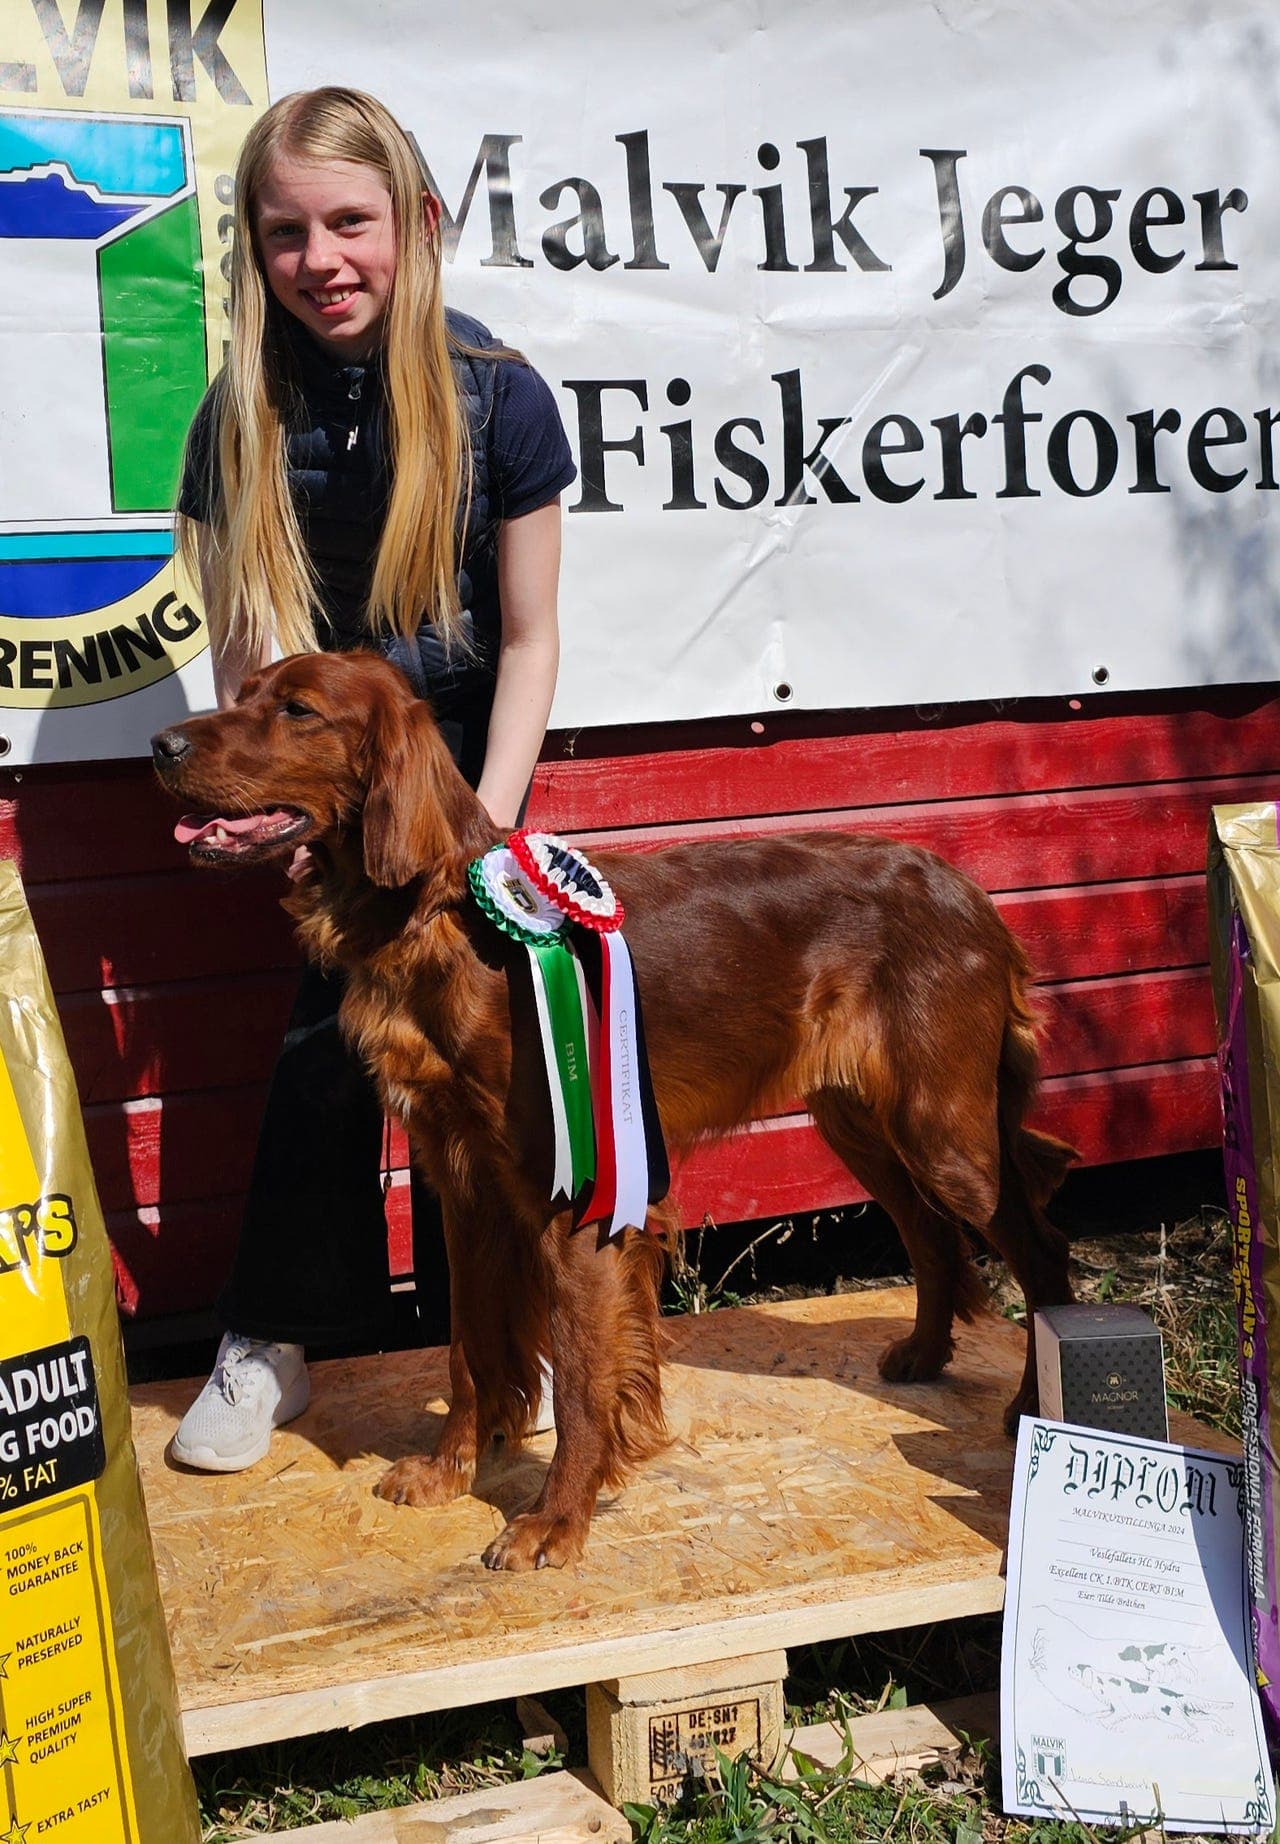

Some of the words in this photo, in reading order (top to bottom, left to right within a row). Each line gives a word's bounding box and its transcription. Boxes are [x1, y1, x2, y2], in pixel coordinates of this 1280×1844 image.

[405, 129, 892, 274] Malvik
[918, 149, 1250, 317] Jeger
[565, 1042, 577, 1083] BIM
[618, 1008, 633, 1126] CERTIFIKAT
[0, 1350, 87, 1416] ADULT
[1091, 1390, 1139, 1403] MAGNOR
[25, 1406, 95, 1455] FOOD
[1246, 1380, 1261, 1508] PROFESSIONAL
[23, 1458, 58, 1492] FAT
[1063, 1440, 1218, 1517] DIPLOM
[1167, 1525, 1186, 1535] 2024
[5, 1541, 38, 1562] 100%
[6, 1553, 51, 1580] MONEY
[54, 1540, 84, 1562] BACK
[1154, 1559, 1181, 1574] Hydra
[1251, 1513, 1266, 1600] FORMULA
[9, 1560, 79, 1597] GUARANTEE
[1049, 1565, 1088, 1580] Excellent
[1135, 1580, 1163, 1595] CERT
[1163, 1585, 1185, 1598] BIM
[1097, 1593, 1115, 1604] Tilde
[15, 1616, 81, 1653] NATURALLY
[17, 1633, 83, 1670] PRESERVED
[25, 1709, 55, 1730] HIGH
[57, 1691, 93, 1716] SUPER
[27, 1713, 83, 1747] PREMIUM
[29, 1732, 78, 1765] QUALITY
[1032, 1736, 1065, 1750] MALVIK
[37, 1805, 75, 1834] EXTRA
[76, 1787, 111, 1816] TASTY
